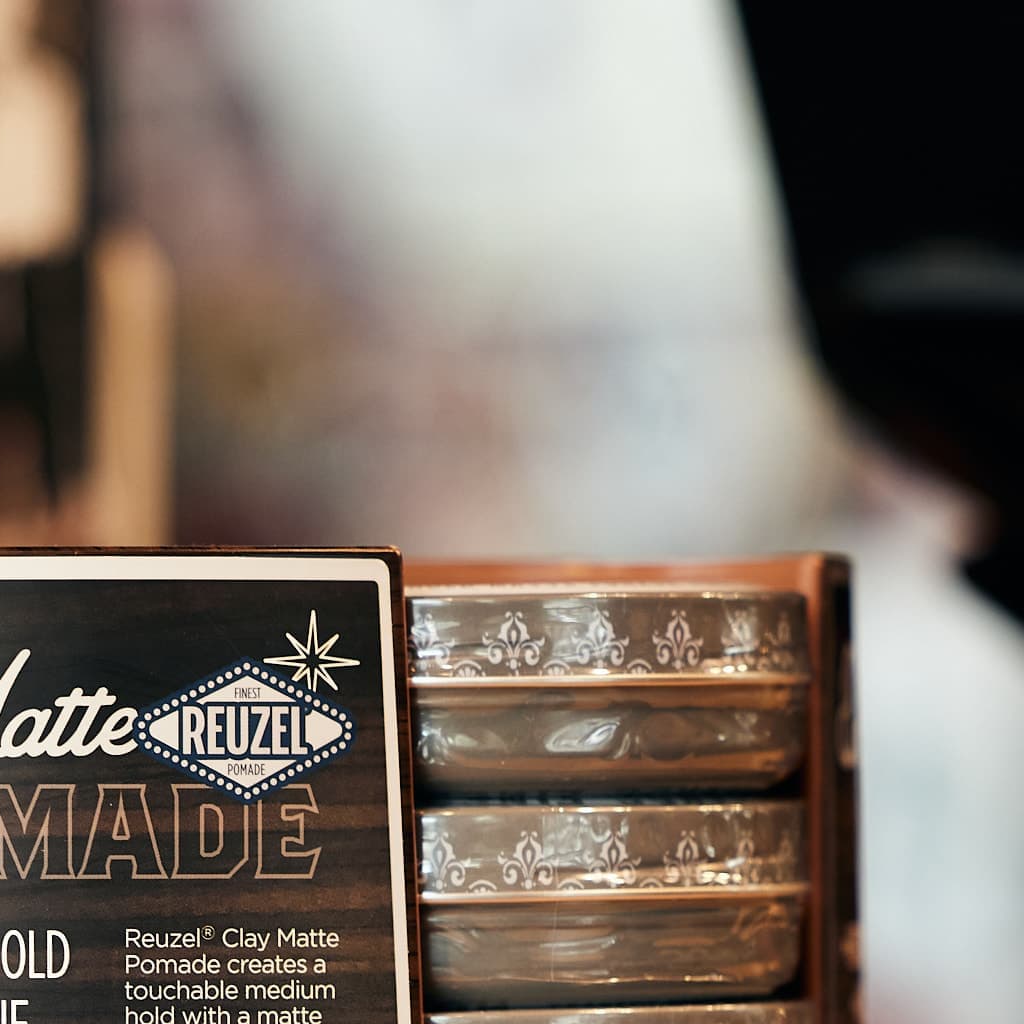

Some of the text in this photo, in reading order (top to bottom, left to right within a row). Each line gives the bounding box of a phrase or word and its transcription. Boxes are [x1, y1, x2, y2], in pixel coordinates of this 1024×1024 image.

[234, 687, 261, 699] FINEST
[182, 706, 309, 755] REUZEL
[227, 763, 266, 776] POMADE
[222, 927, 271, 952] Clay
[277, 927, 340, 948] Matte
[125, 953, 327, 975] Pomade creates a
[124, 979, 336, 1001] touchable medium
